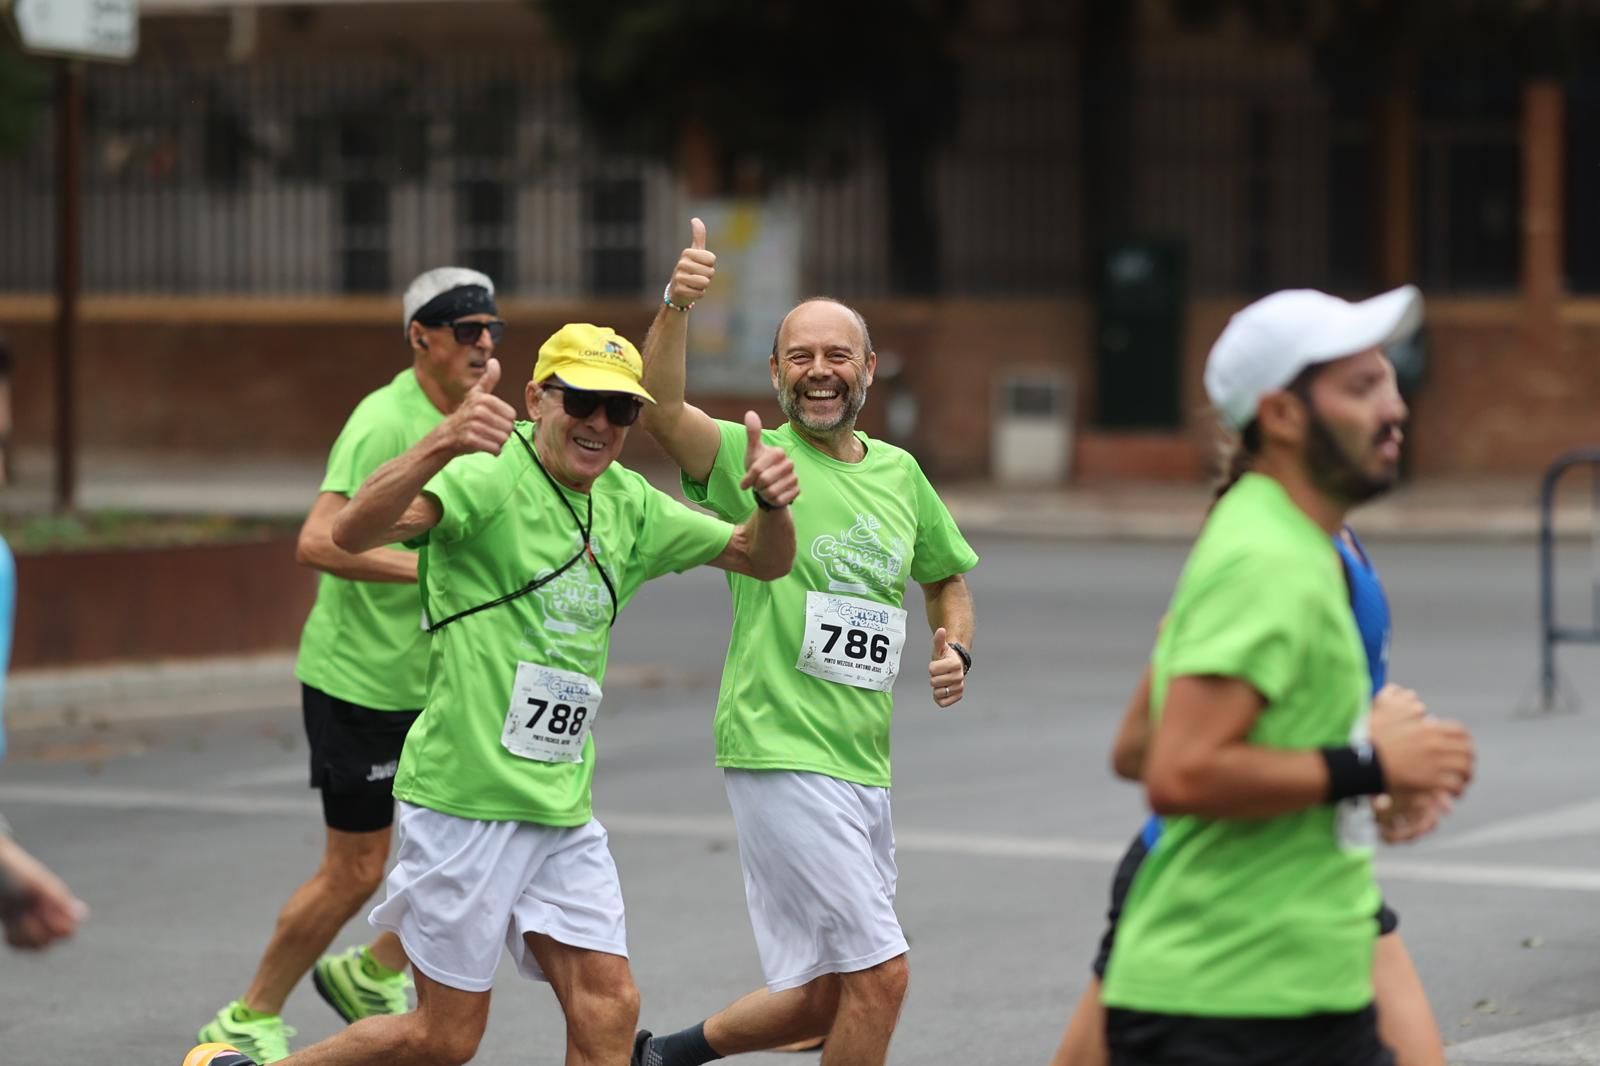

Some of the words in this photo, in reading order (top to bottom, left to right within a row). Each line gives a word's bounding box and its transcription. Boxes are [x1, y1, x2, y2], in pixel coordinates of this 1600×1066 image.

[578, 350, 607, 359] LORO
[839, 603, 881, 622] Carrera
[820, 623, 890, 664] 786
[824, 657, 836, 666] PINTO
[525, 697, 588, 736] 788
